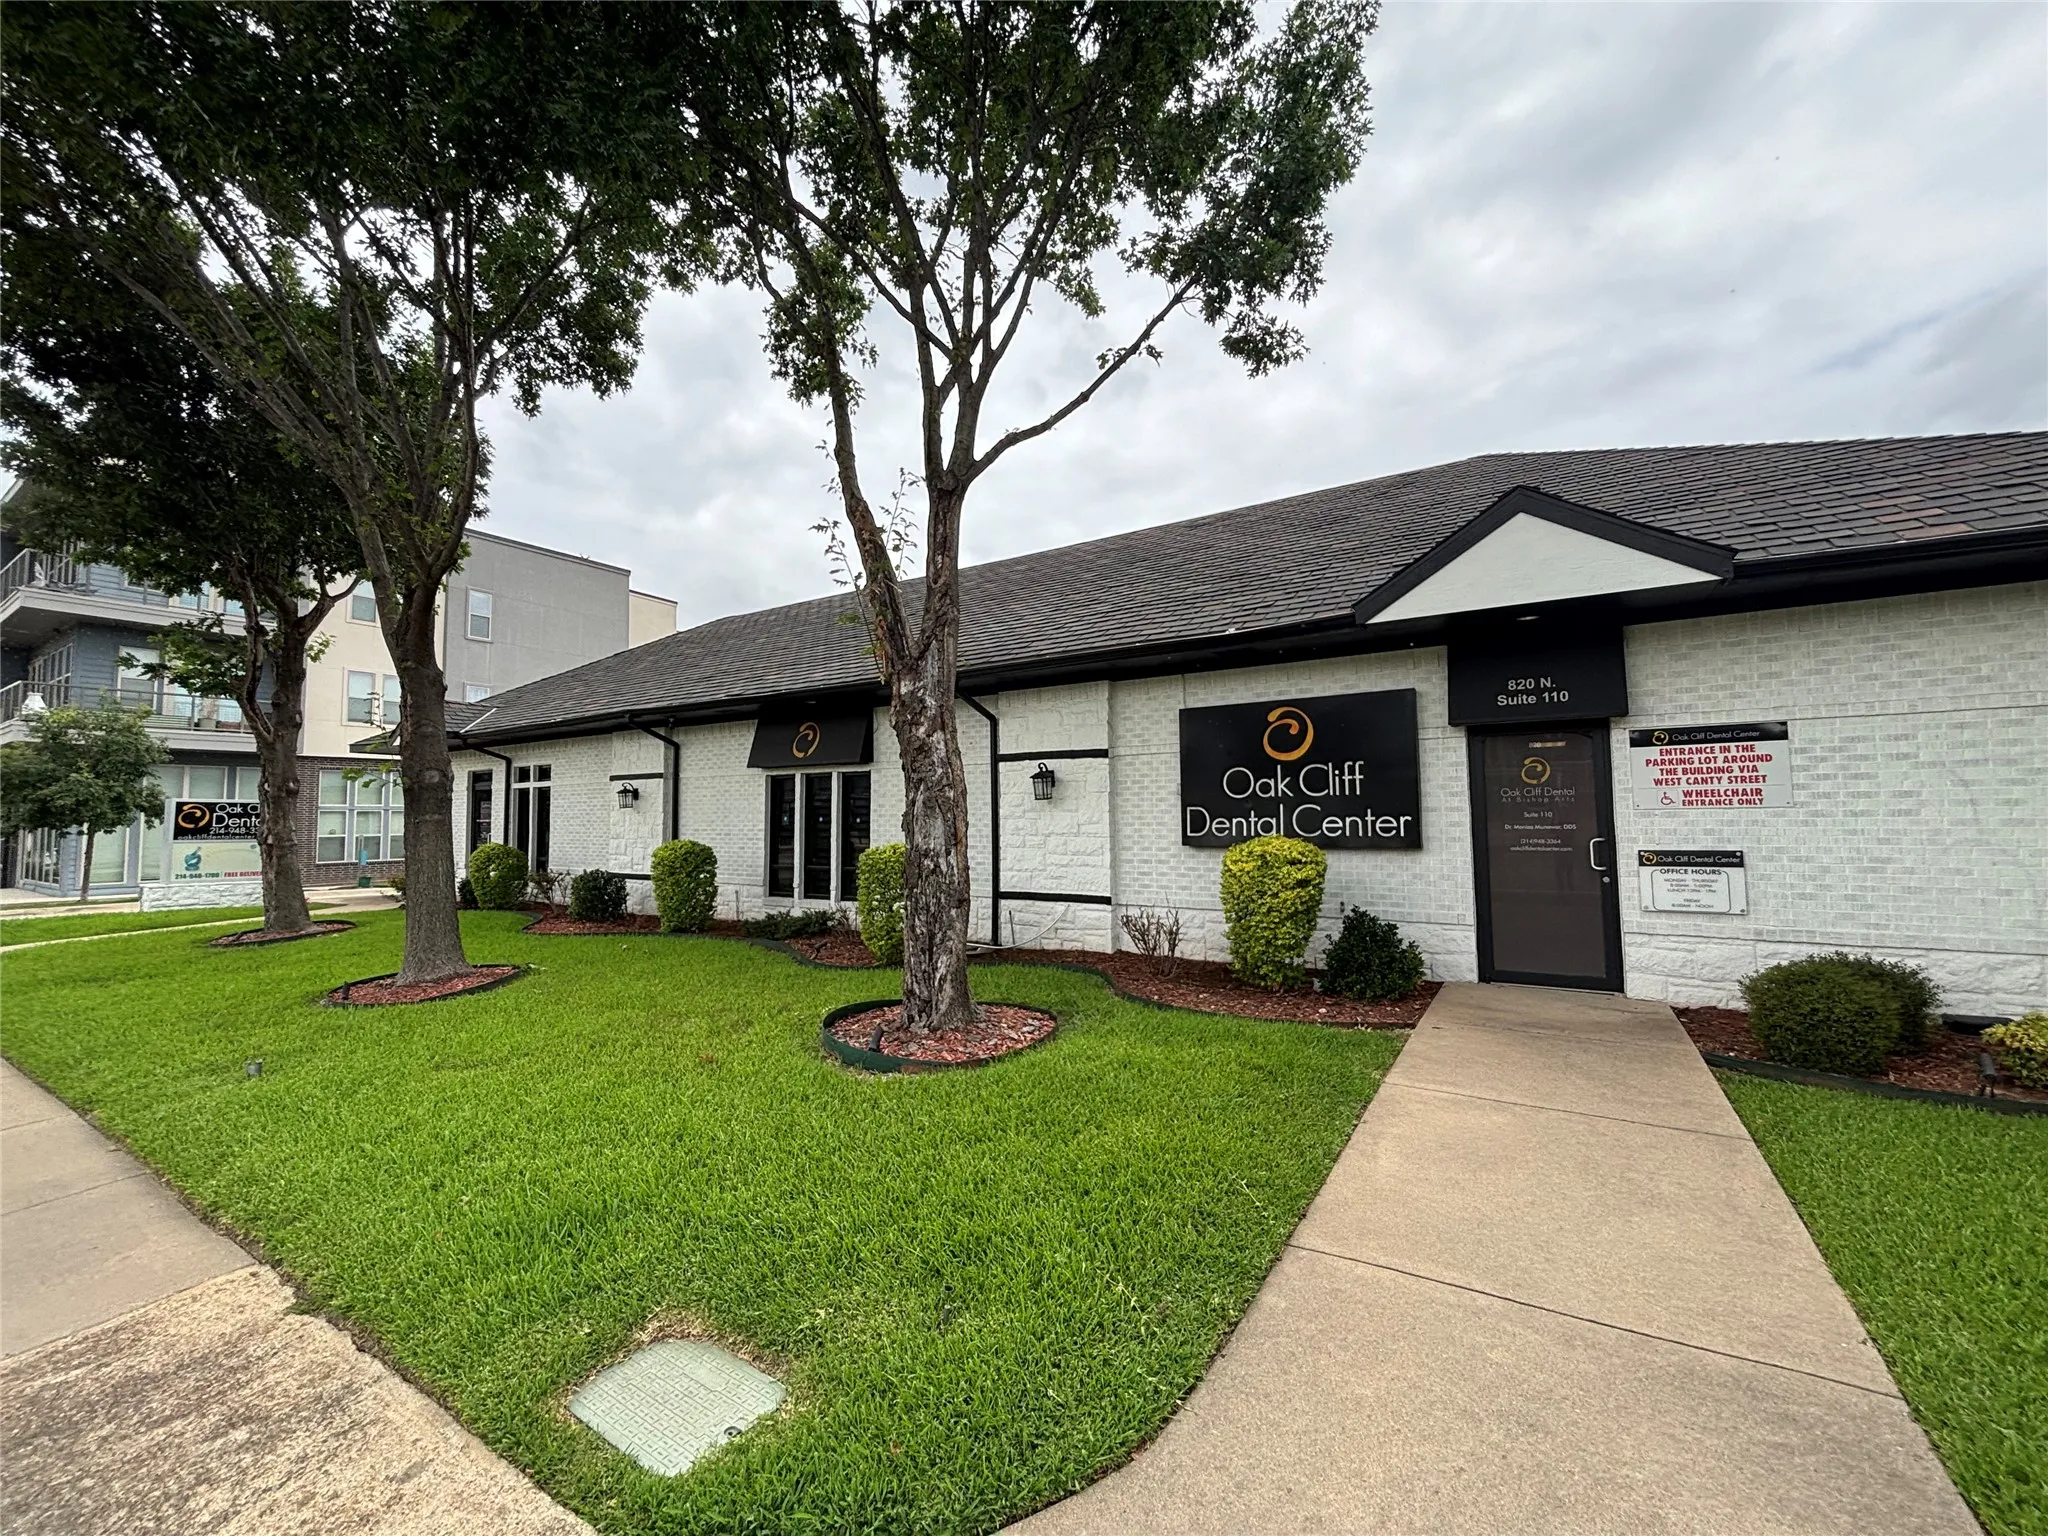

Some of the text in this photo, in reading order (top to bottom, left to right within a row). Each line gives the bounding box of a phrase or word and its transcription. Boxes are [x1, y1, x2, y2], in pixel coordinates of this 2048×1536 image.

[1508, 677, 1556, 690] 820 N.
[1496, 690, 1569, 706] Suite 110
[1672, 730, 1760, 741] Oak Cliff Dental Center
[1659, 744, 1756, 756] ENTRANCE IN THE
[1645, 754, 1773, 767] PARKING LOT AROUND
[1659, 764, 1759, 776] THE BUILDING VIA
[1222, 760, 1364, 799] Oak Cliff
[1653, 774, 1768, 787] WEST CANTY STREET
[1500, 786, 1575, 797] Oak Cliff Dental
[1682, 787, 1763, 799] WHEELCHAIR
[1682, 797, 1764, 807] ENTRANCE ONLY
[216, 803, 261, 814] Oak Cl
[1186, 803, 1412, 837] Dental Center
[1689, 855, 1714, 863] Dental
